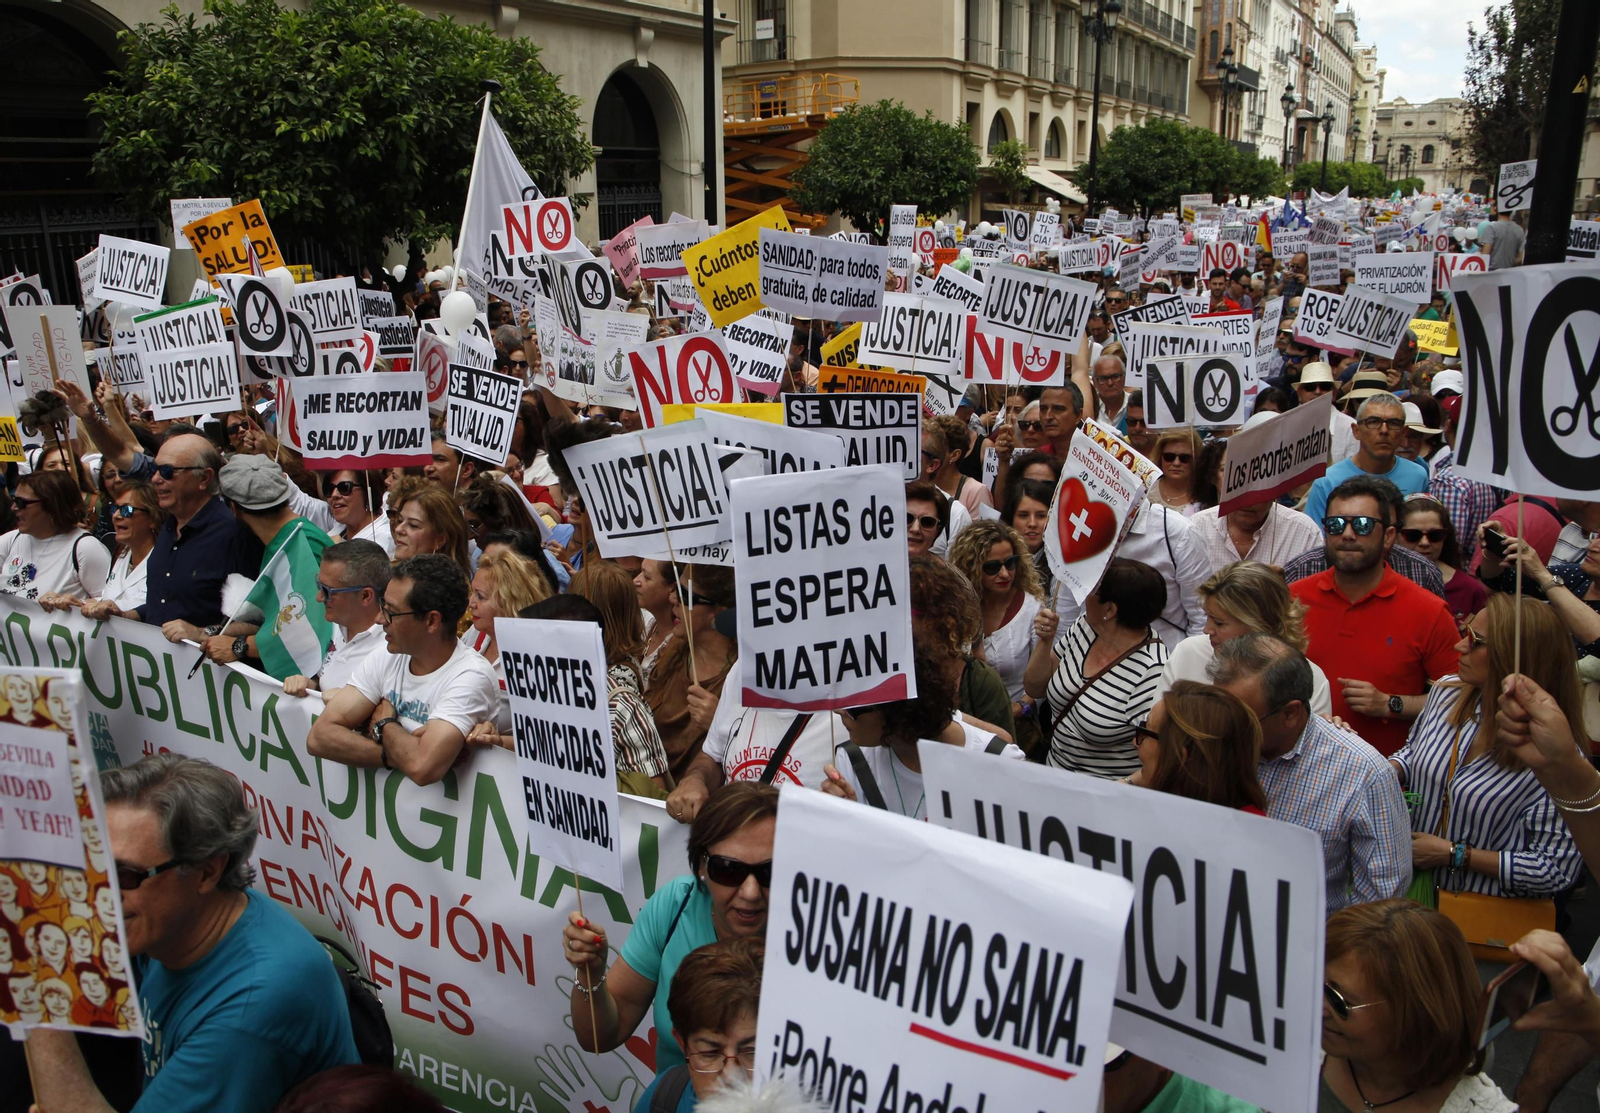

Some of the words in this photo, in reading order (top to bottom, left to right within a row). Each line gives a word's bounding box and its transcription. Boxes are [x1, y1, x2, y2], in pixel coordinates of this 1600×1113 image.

[190, 221, 234, 254] ¡Por
[240, 211, 265, 230] la
[503, 201, 572, 257] NO
[1004, 210, 1029, 242] NO
[1033, 234, 1053, 246] CIA!
[1036, 213, 1058, 225] JUS-
[1039, 224, 1051, 234] TI-
[203, 236, 276, 275] SALUD!
[640, 242, 655, 265] Los
[655, 240, 687, 263] recortes
[694, 240, 760, 290] ¿Cuántos
[761, 241, 818, 271] SANIDAD:
[820, 256, 844, 278] para
[847, 258, 882, 284] todos,
[1060, 247, 1096, 269] ¡JUSTICIA!
[1273, 246, 1282, 256] TU
[1284, 242, 1309, 255] SALUD!
[99, 246, 164, 297] ¡JUSTICIA!
[762, 276, 807, 305] gratuita,
[812, 282, 827, 304] de
[830, 287, 878, 309] calidad.
[1357, 263, 1429, 280] "PRIVATIZACIÓN",
[1390, 280, 1427, 295] LADRÓN.
[713, 281, 758, 313] deben
[982, 275, 1089, 341] ¡JUSTICIA!
[1135, 301, 1185, 323] VENDE
[730, 323, 789, 355] RECORTAN
[865, 304, 963, 359] ¡JUSTICIA!
[1301, 317, 1312, 333] TU
[1334, 294, 1410, 346] ¡JUSTICIA!
[964, 314, 1063, 383] NO
[150, 354, 235, 406] ¡JUSTICIA!
[451, 369, 469, 396] SE
[472, 373, 519, 412] VENDE
[627, 336, 734, 430] NO
[736, 361, 747, 376] y
[749, 359, 782, 383] VIDA!
[1146, 358, 1241, 425] NO
[1453, 276, 1600, 492] NO
[303, 393, 332, 420] ¡ME
[335, 391, 423, 413] RECORTAN
[790, 400, 822, 426] SE
[830, 399, 917, 427] VENDE
[306, 430, 358, 453] SALUD
[361, 434, 373, 455] y
[378, 427, 425, 450] VIDA!
[842, 435, 912, 470] ALUD.
[1227, 460, 1247, 495] Los
[1247, 440, 1293, 484] recortes
[1294, 425, 1338, 466] matan.
[1071, 446, 1106, 486] SANIDAD
[1103, 477, 1131, 503] DIGNA
[1088, 447, 1104, 465] POR
[1103, 459, 1122, 482] UNA
[577, 442, 724, 533] ¡JUSTICIA!
[744, 498, 852, 559] LISTAS
[860, 495, 896, 542] de
[702, 542, 729, 563] hay
[750, 563, 897, 629] ESPERA
[501, 650, 597, 712] RECORTES
[755, 631, 900, 692] MATAN.
[47, 616, 312, 790] PÚBLICA
[513, 712, 608, 780] HOMICIDAS
[18, 810, 74, 840] YEAH!
[522, 775, 546, 825] EN
[543, 782, 614, 853] SANIDAD.
[941, 789, 1290, 1052] ICIA!
[785, 871, 914, 1009] SUSANA
[910, 914, 974, 1027] NO
[973, 932, 1087, 1068] SANA.
[769, 1020, 868, 1113] ¡Pobre
